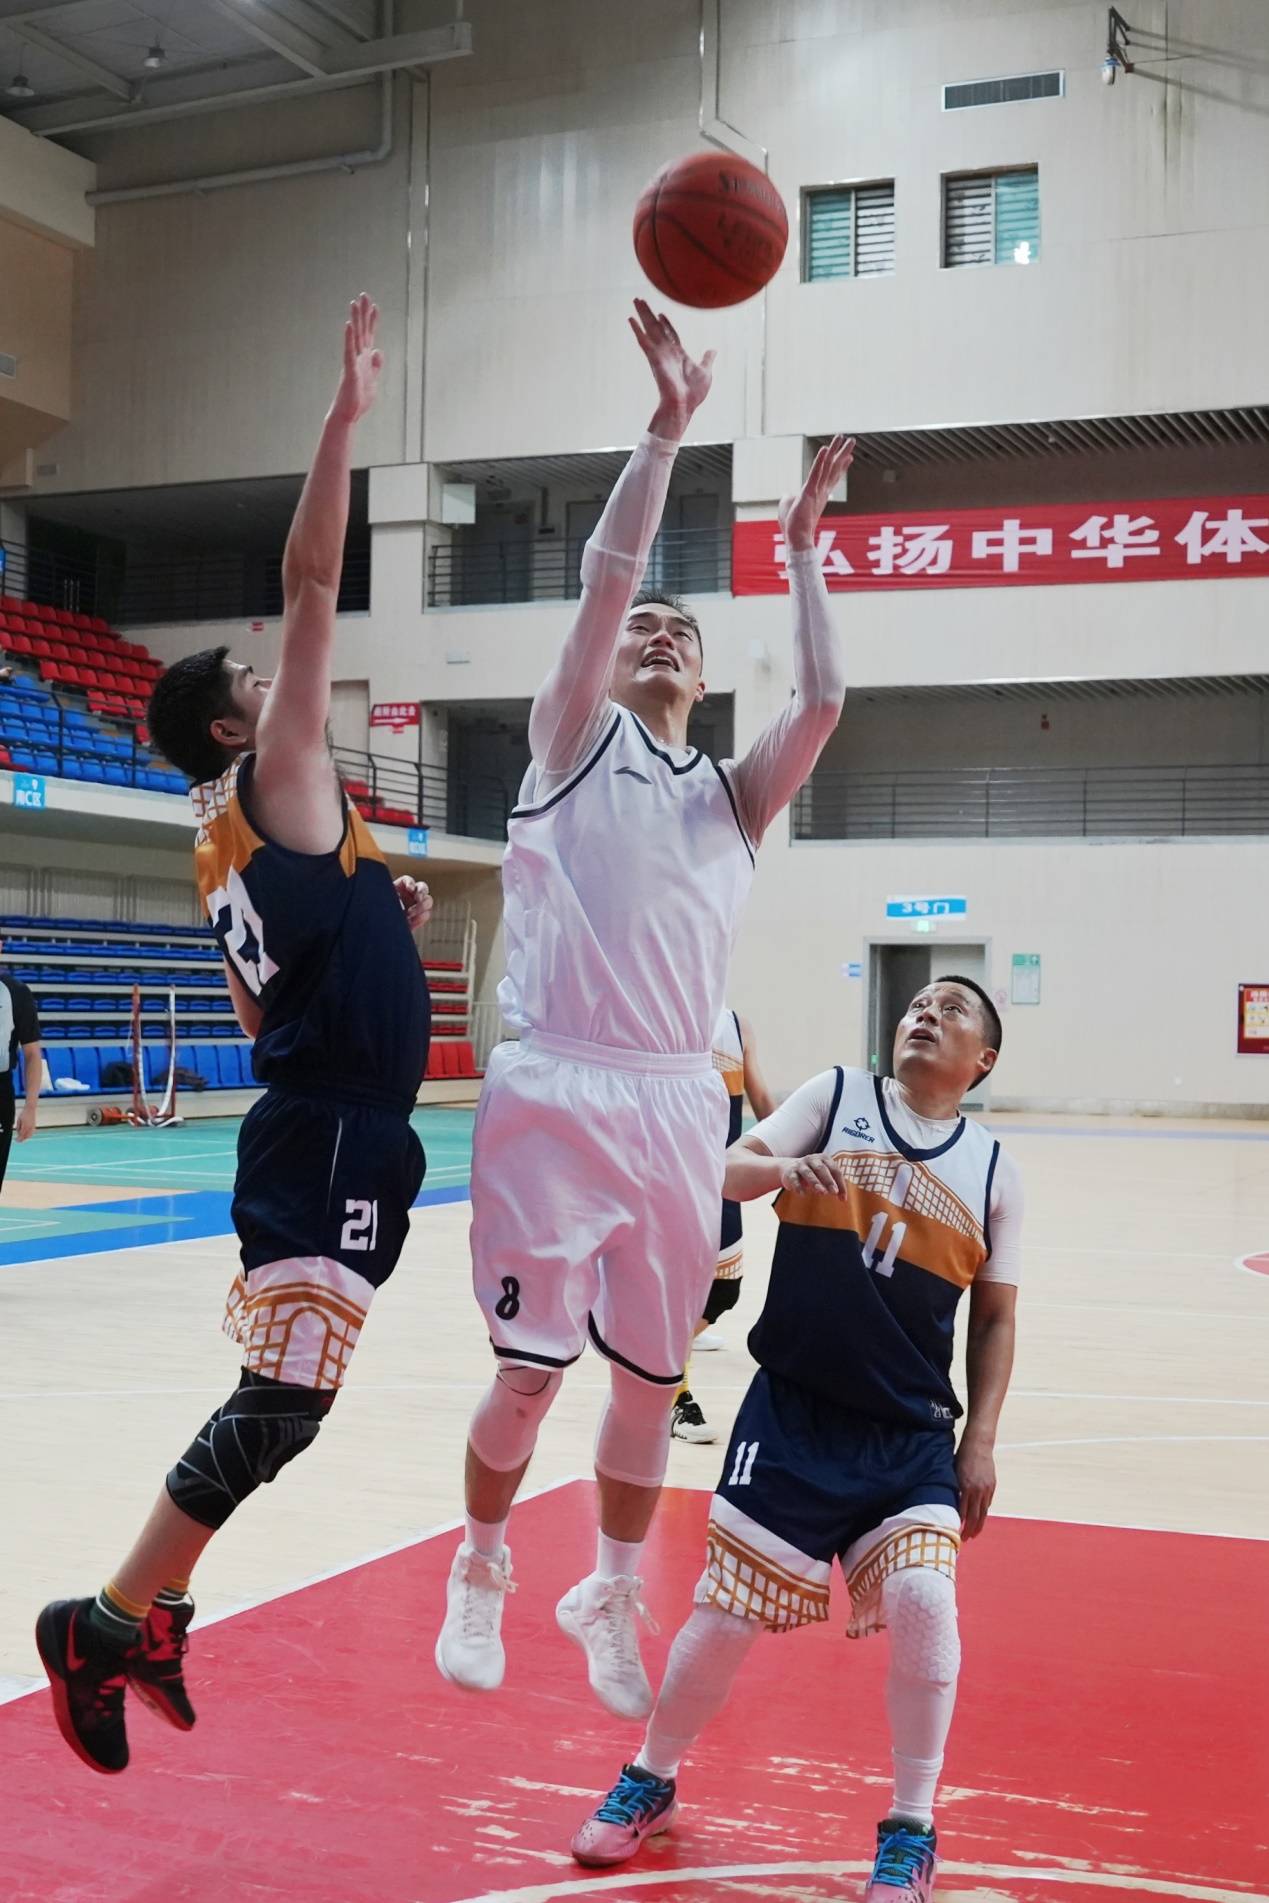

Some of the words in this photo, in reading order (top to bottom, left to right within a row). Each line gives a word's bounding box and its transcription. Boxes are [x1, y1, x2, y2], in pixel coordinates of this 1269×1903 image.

[340, 1198, 378, 1251] 21
[861, 1211, 907, 1278] 11
[494, 1275, 520, 1321] 8
[728, 1441, 760, 1486] 11
